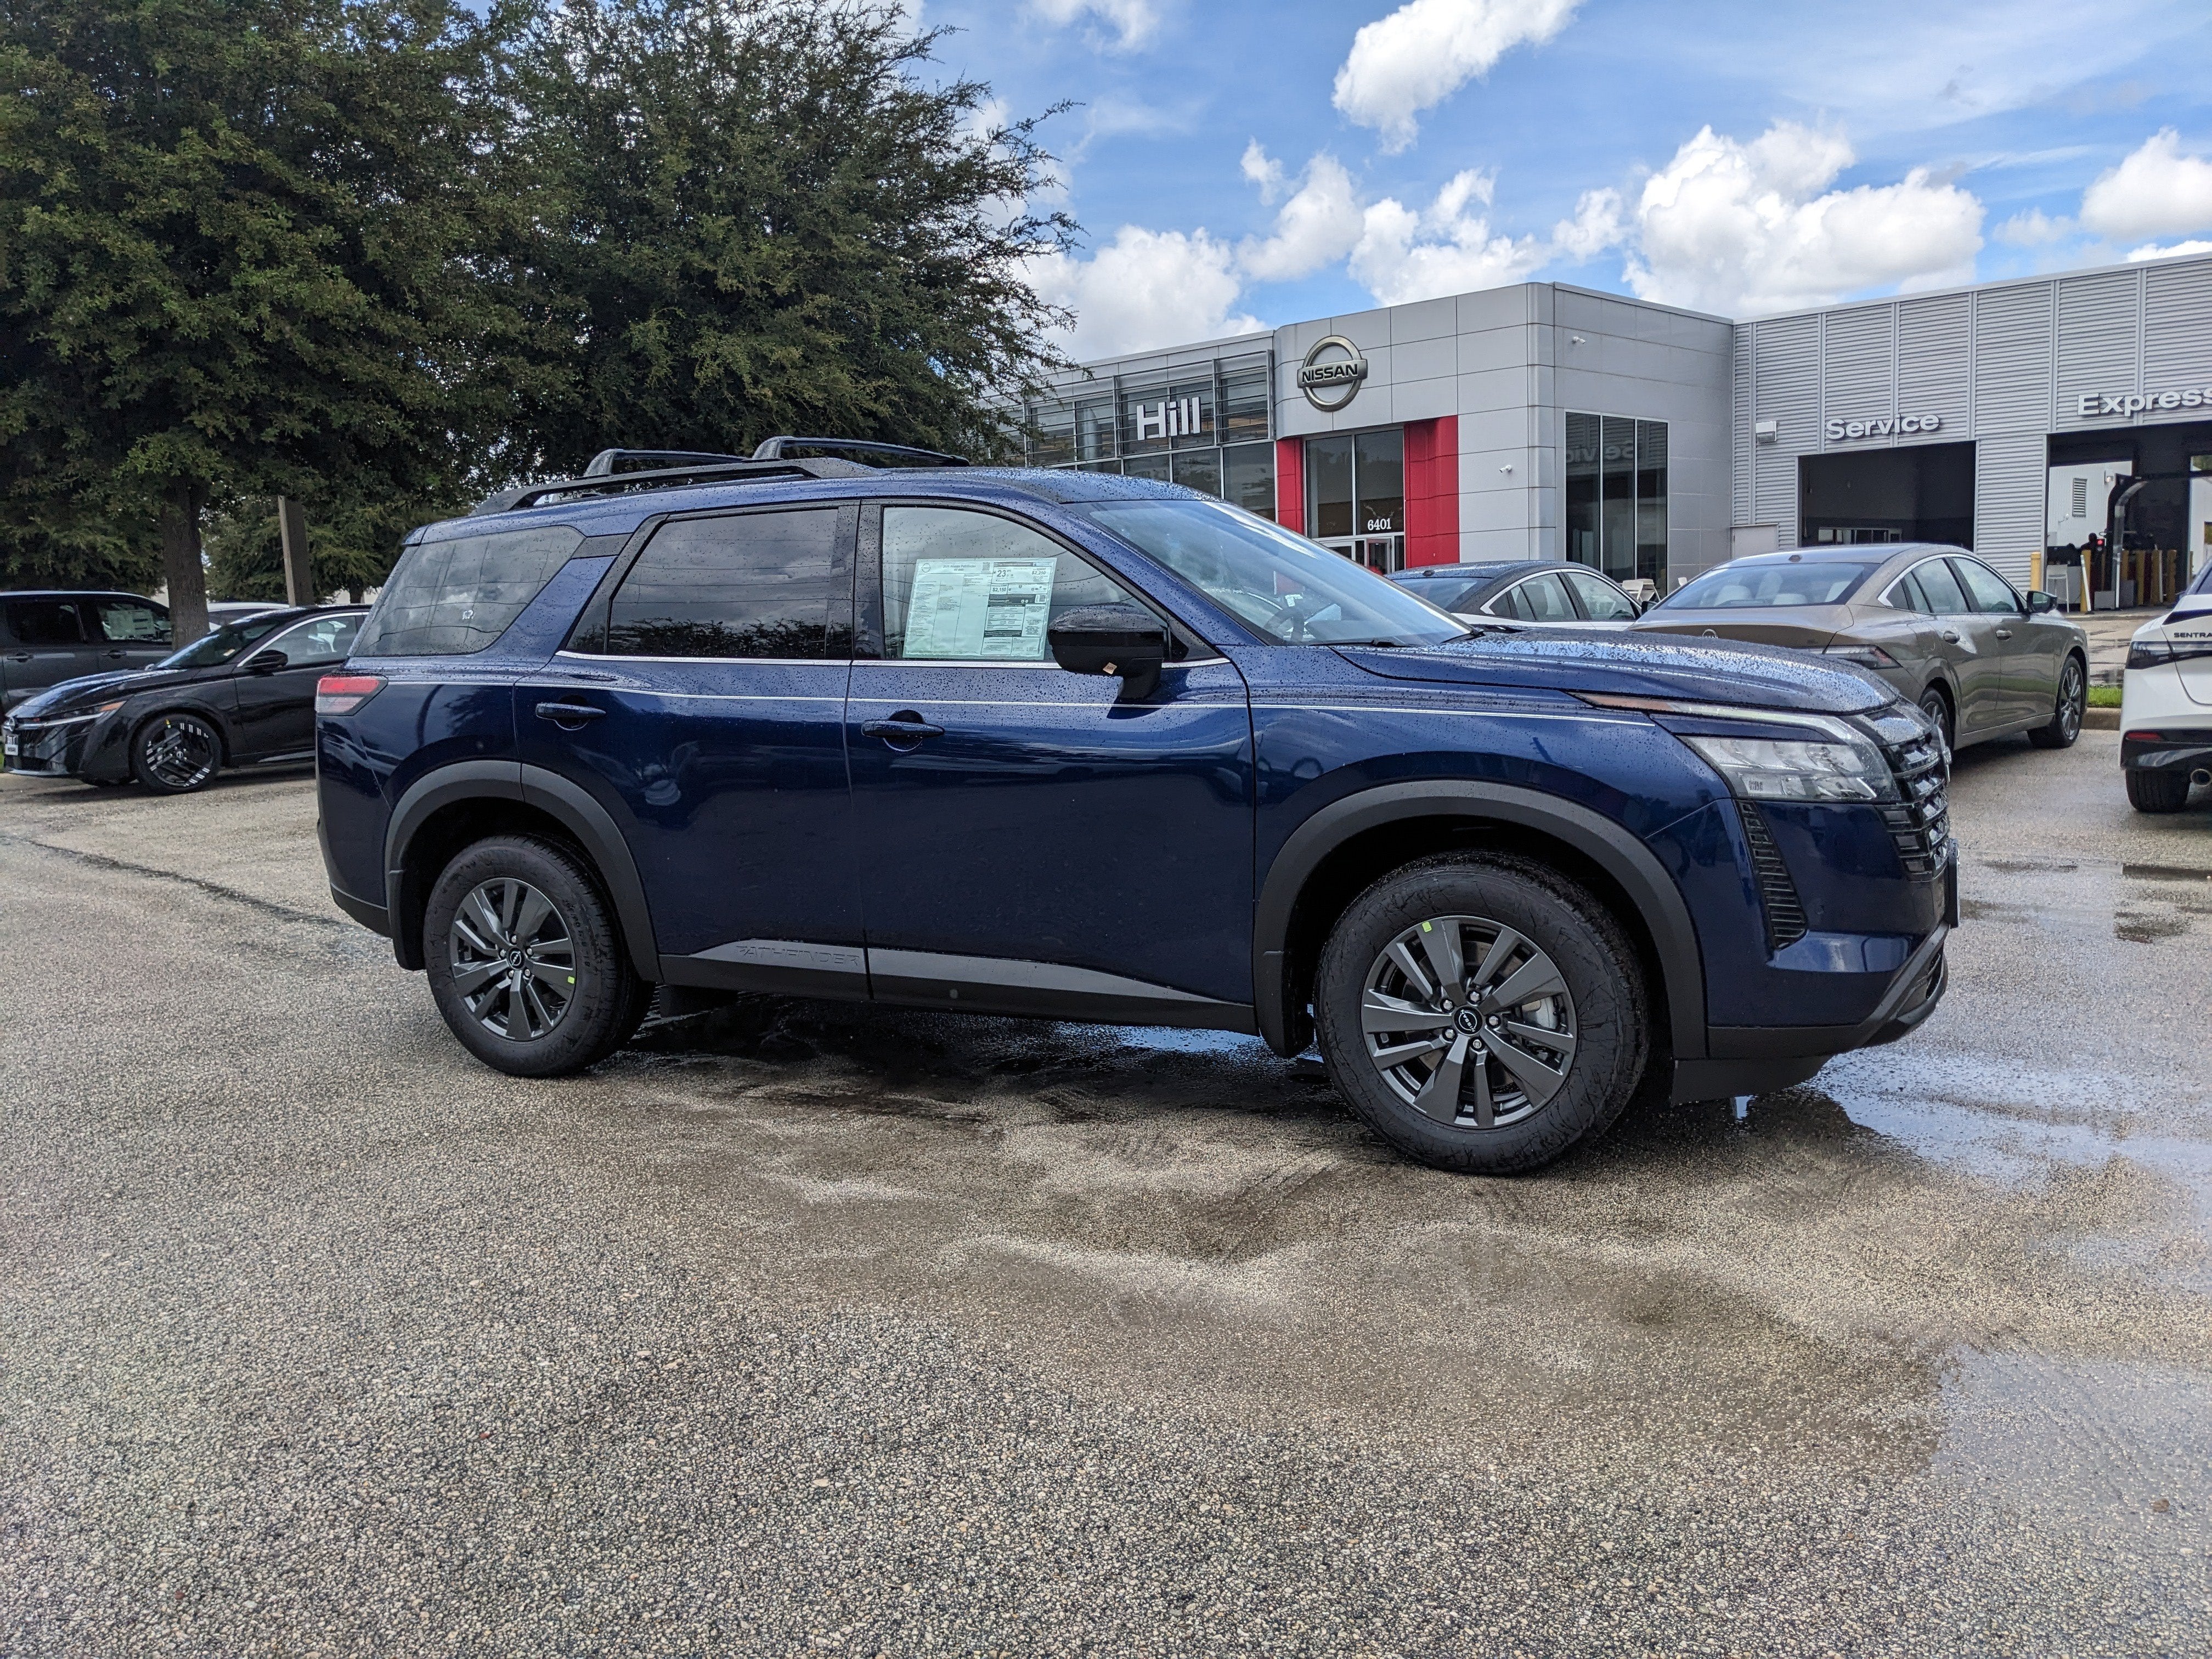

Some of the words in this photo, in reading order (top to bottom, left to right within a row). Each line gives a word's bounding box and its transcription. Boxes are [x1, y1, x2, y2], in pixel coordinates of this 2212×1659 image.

[1302, 364, 1358, 383] NISSAN
[1136, 397, 1201, 441] Hill
[1825, 413, 1940, 439] Service
[1367, 518, 1392, 531] 6401
[736, 945, 860, 966] PATHFINDER
[1460, 1009, 1476, 1032] NISSAN
